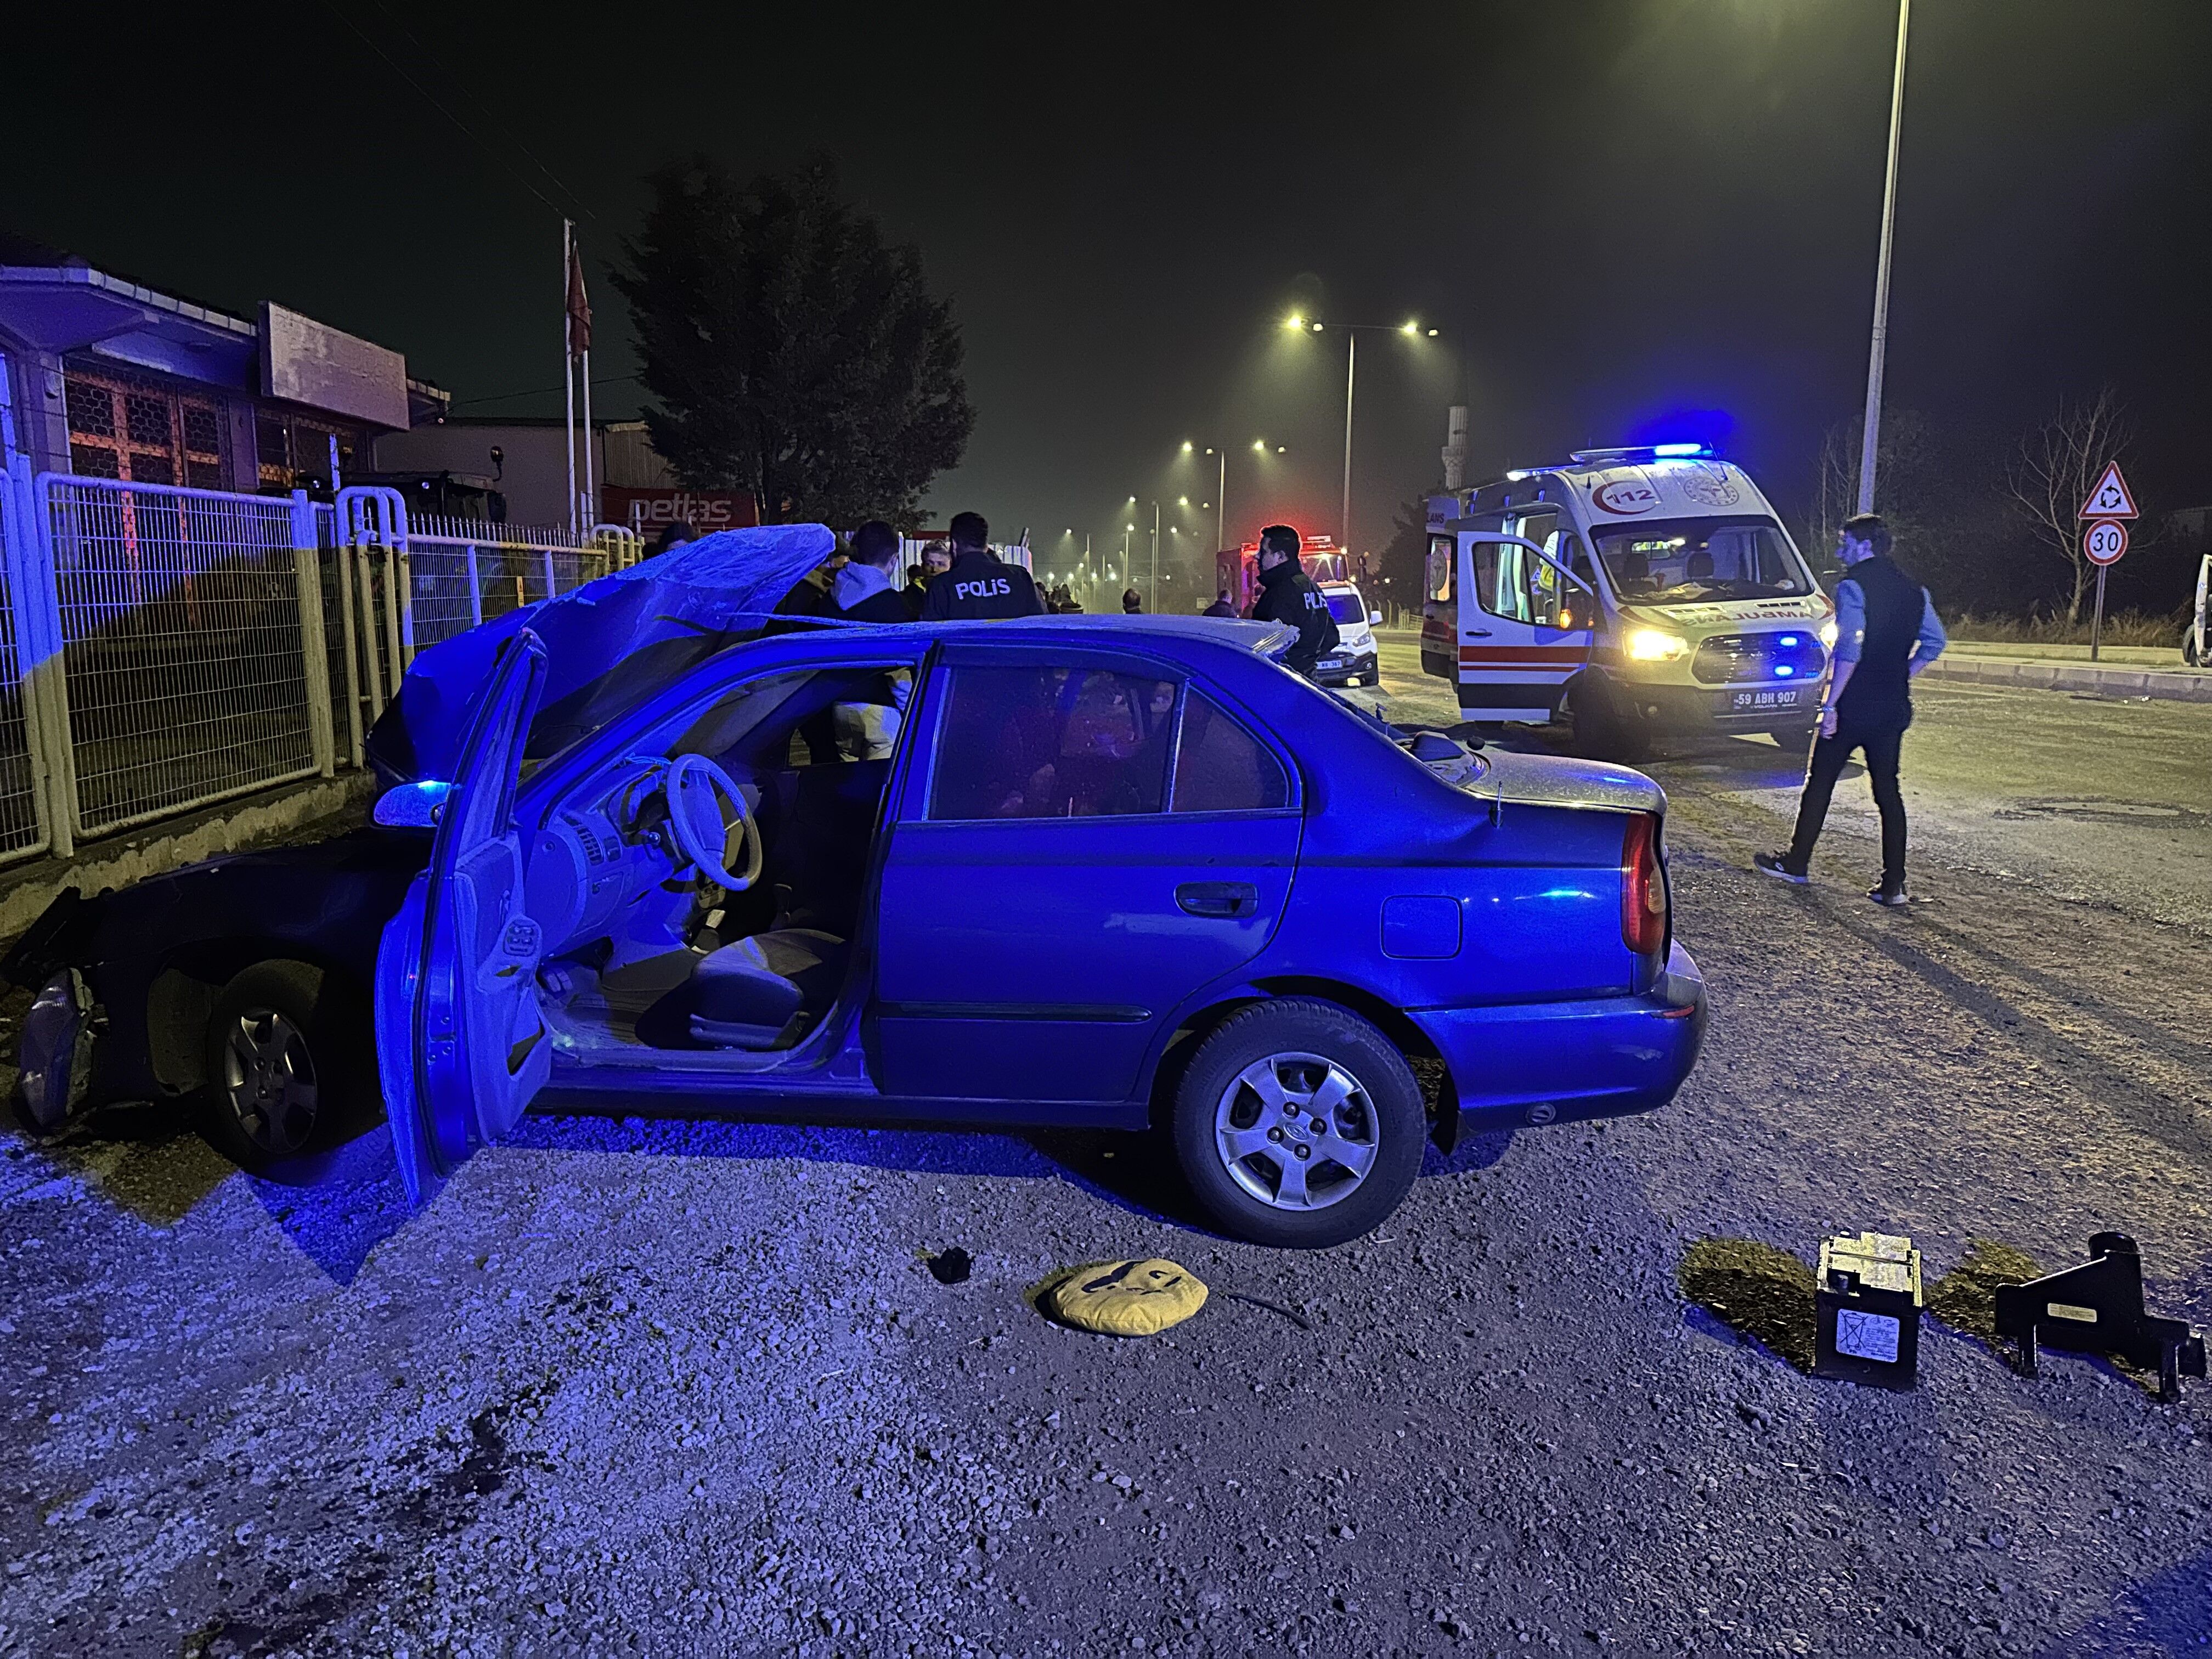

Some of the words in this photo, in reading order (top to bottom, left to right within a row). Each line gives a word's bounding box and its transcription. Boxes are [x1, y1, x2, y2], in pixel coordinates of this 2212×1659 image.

[1606, 489, 1655, 504] 112
[627, 493, 731, 527] petlas
[2093, 532, 2119, 552] 30
[1739, 693, 1752, 704] 59
[1754, 692, 1775, 704] ABH
[1778, 691, 1797, 703] 907
